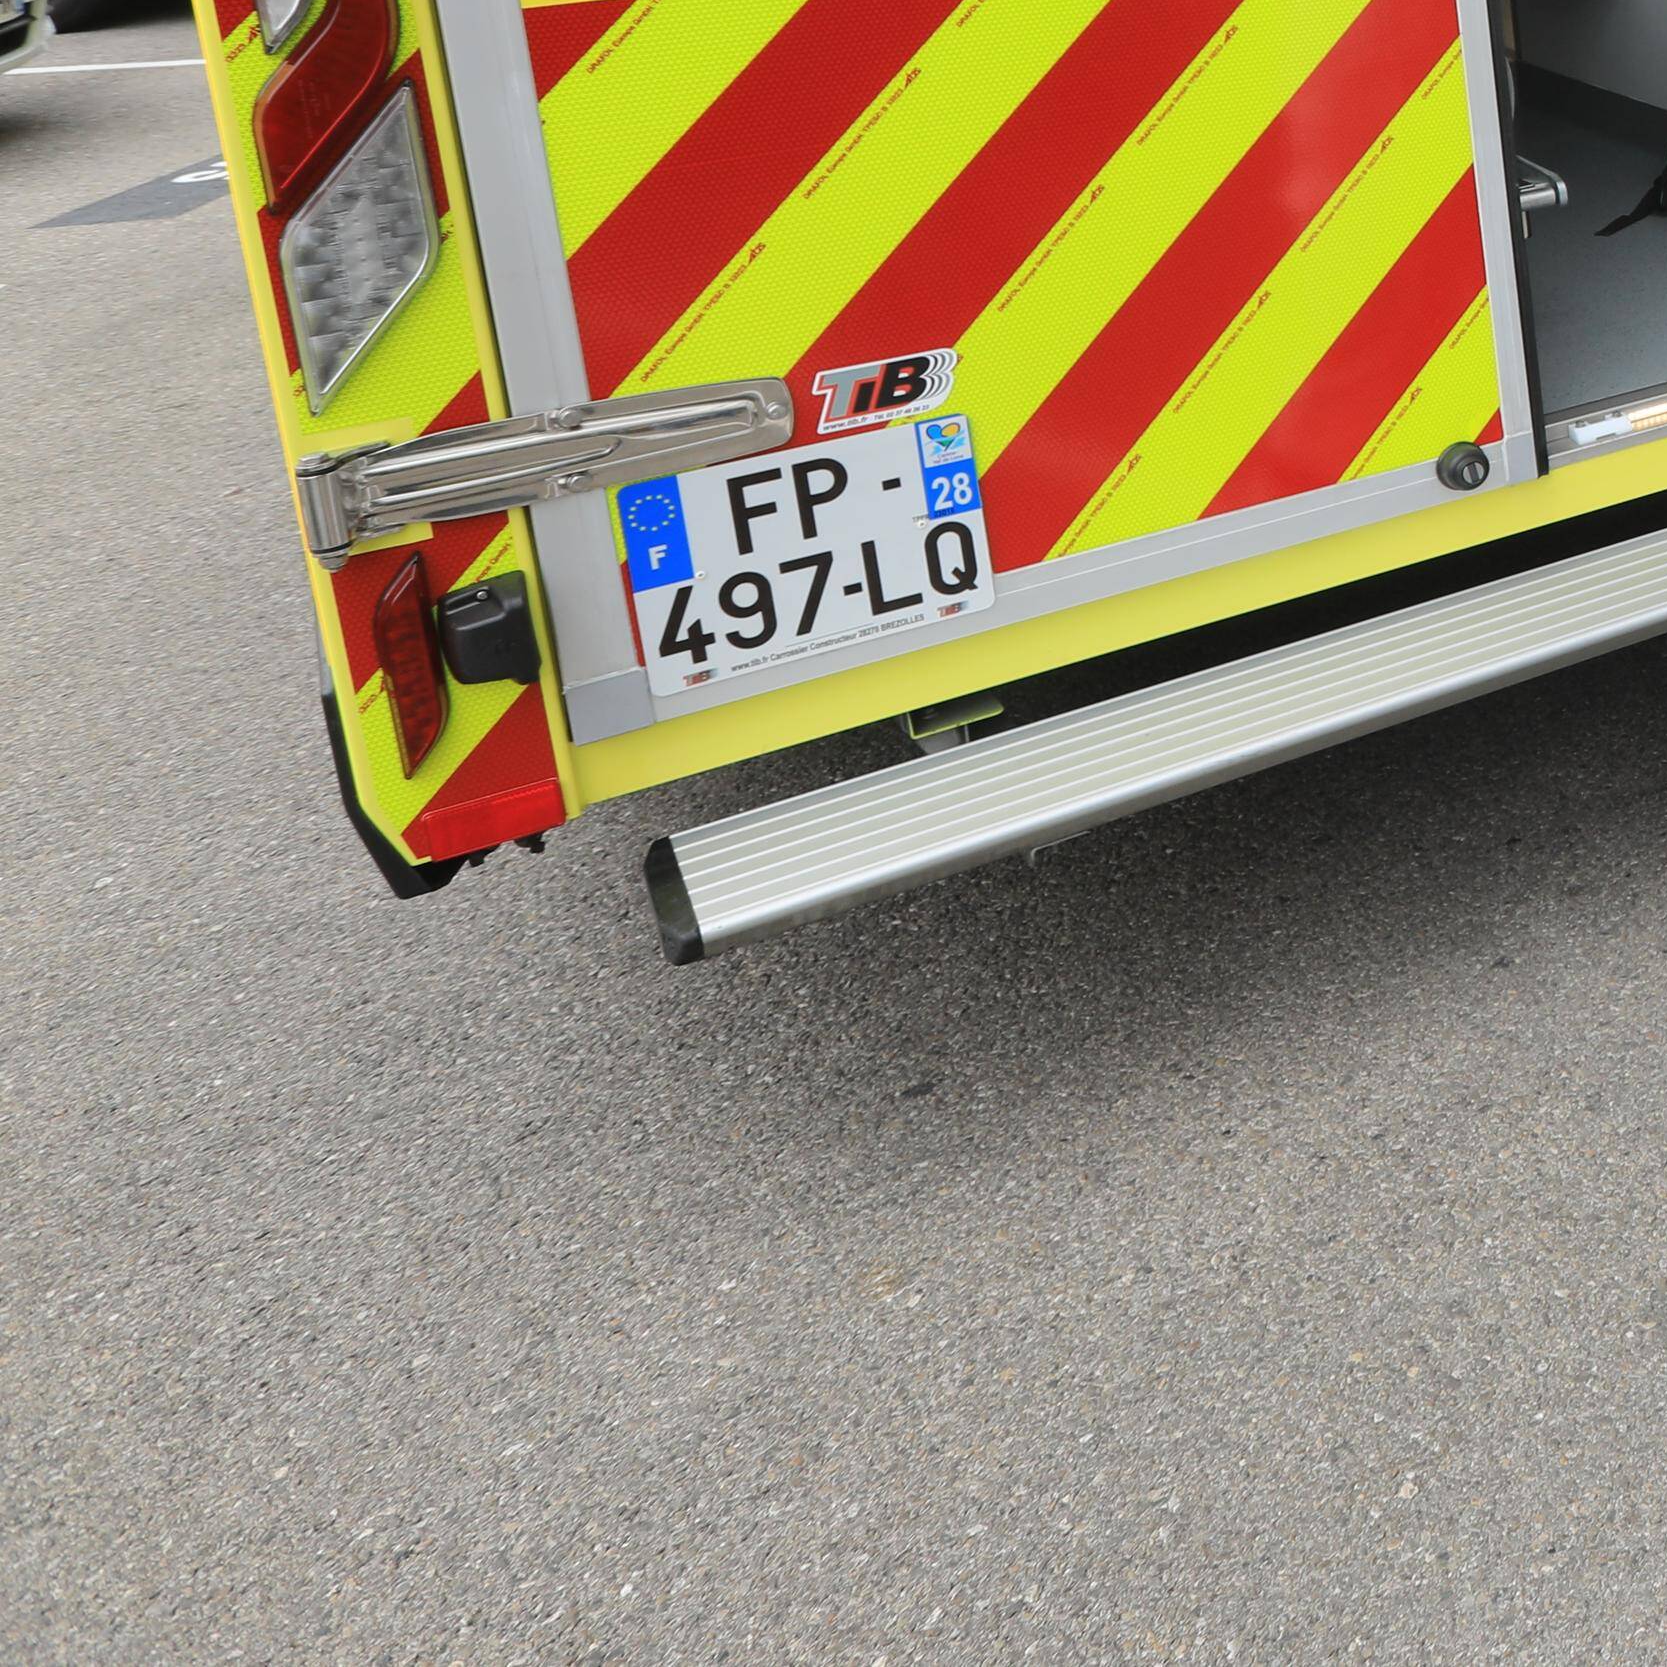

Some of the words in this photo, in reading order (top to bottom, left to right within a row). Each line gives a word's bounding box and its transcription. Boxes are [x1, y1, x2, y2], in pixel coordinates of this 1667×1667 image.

[726, 457, 848, 556] FP
[931, 472, 973, 511] 28
[647, 544, 669, 571] F
[659, 521, 978, 665] 497-LQ
[770, 644, 810, 662] Carrossier
[810, 632, 857, 651] Constructeur
[880, 613, 925, 632] BREZOLLES
